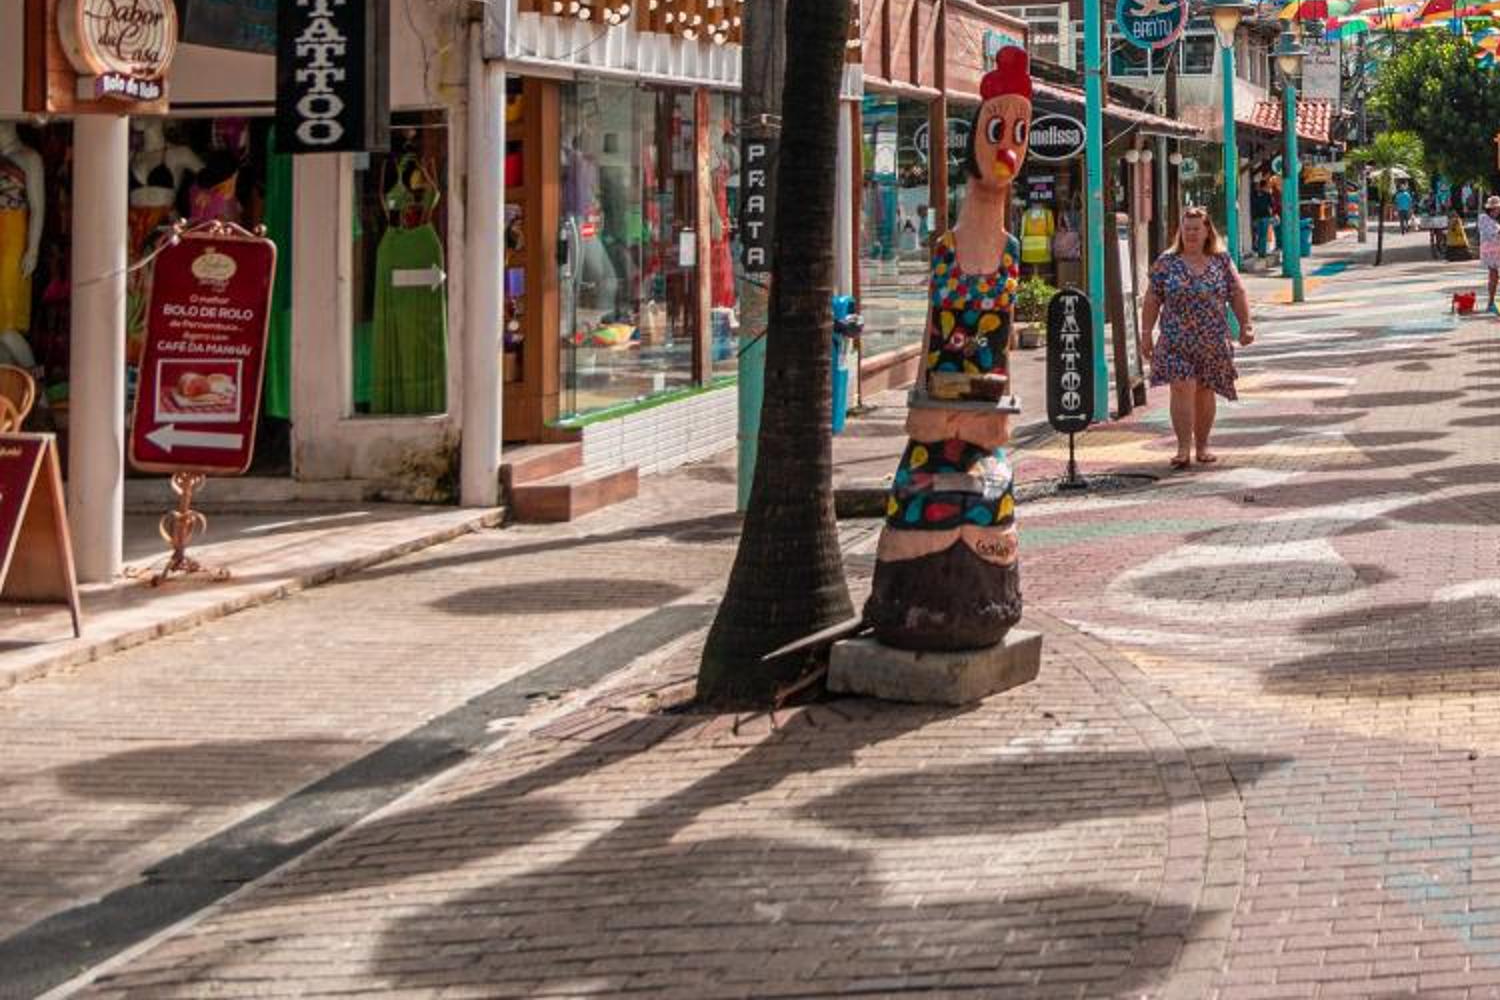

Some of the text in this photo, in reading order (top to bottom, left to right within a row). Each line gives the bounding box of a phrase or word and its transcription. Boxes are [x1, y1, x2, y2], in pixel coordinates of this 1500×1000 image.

[116, 23, 160, 63] Casa
[1029, 125, 1081, 147] melissa
[747, 144, 766, 265] PRATA
[162, 303, 254, 321] BOLO DE ROLO
[1059, 295, 1082, 412] TATTOO
